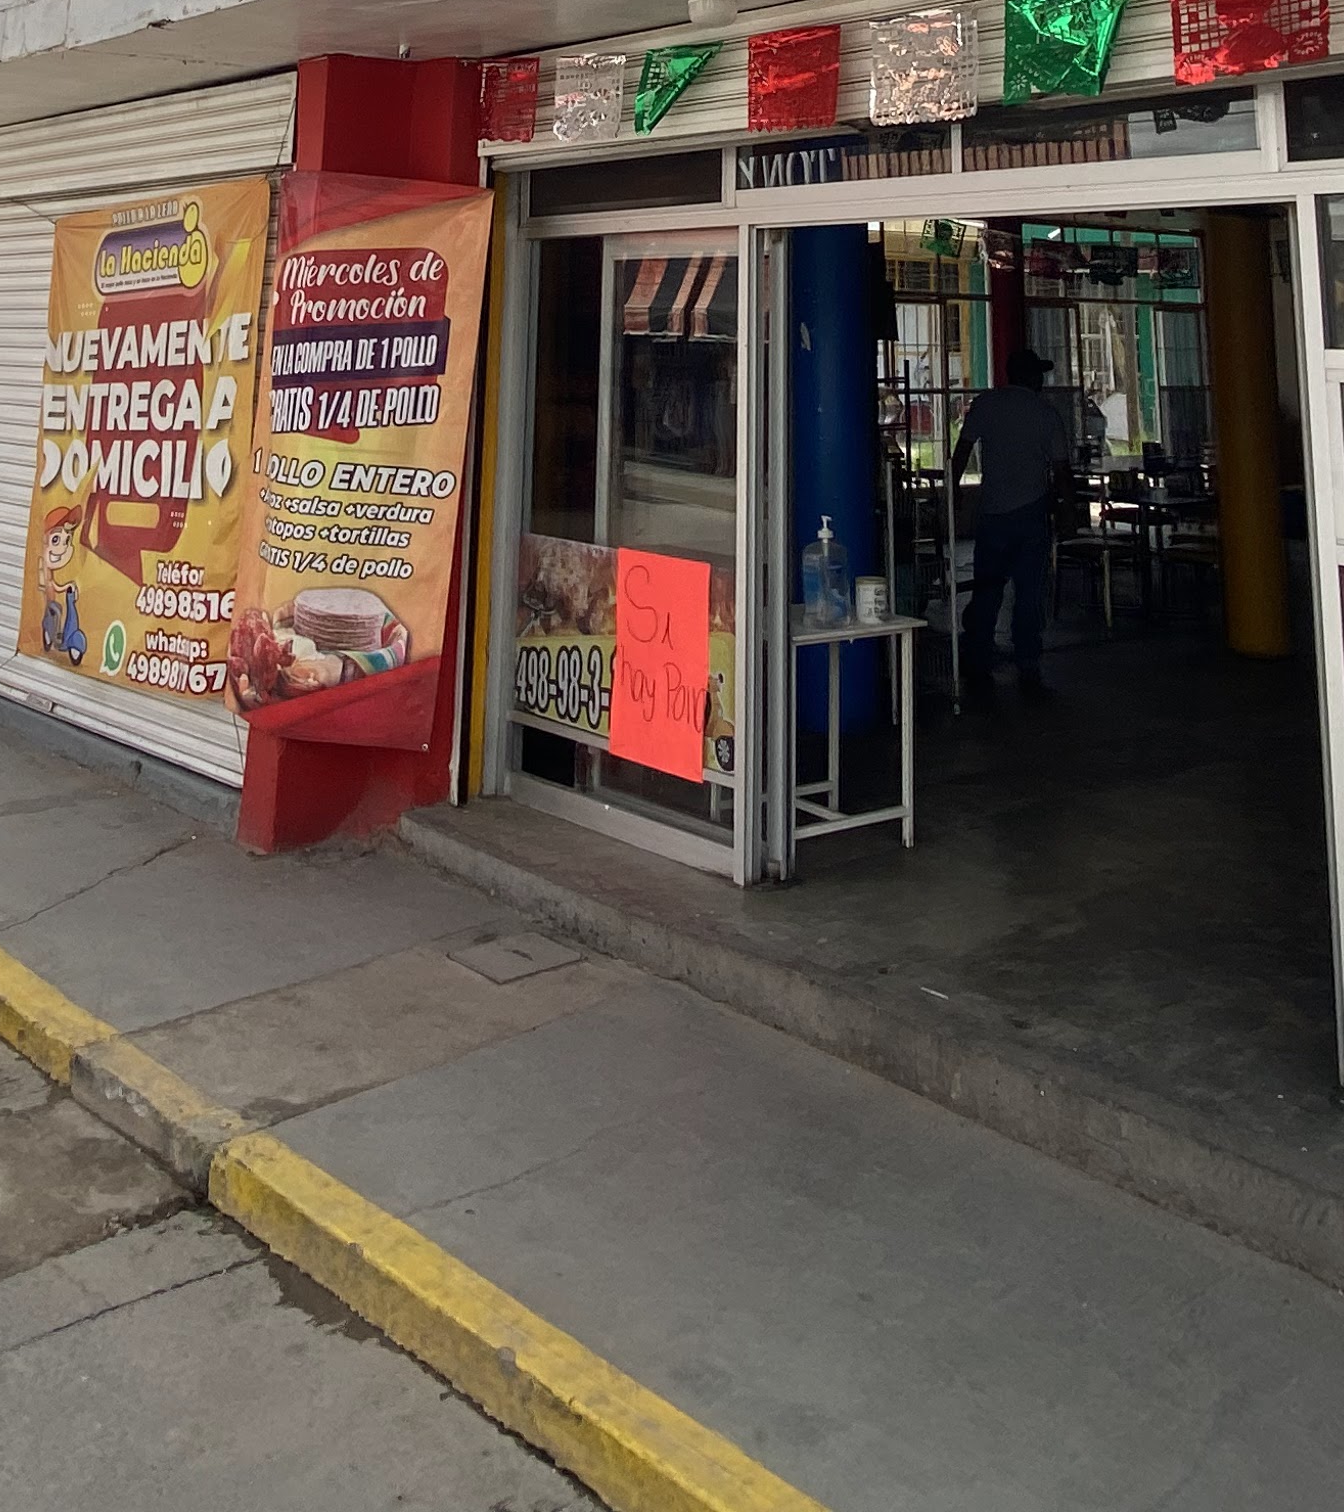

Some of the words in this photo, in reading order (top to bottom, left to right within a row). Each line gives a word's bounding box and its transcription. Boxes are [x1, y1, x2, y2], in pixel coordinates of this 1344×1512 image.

[119, 232, 204, 276] Hacienda
[409, 251, 445, 283] de
[290, 287, 428, 326] Promoción
[294, 339, 353, 375] COMPRA
[355, 337, 377, 371] DE
[380, 337, 388, 370] 1
[390, 334, 438, 369] POLLO
[42, 378, 202, 432] ENTREGA
[317, 389, 353, 431] 1/4
[354, 387, 381, 429] DE
[381, 383, 442, 426] POLLO
[266, 453, 326, 489] OLLO
[329, 461, 457, 499] ENTERO
[345, 501, 435, 525] +verdura
[319, 523, 411, 548] +tortillas
[292, 551, 327, 574] 1/4
[330, 553, 358, 575] de
[359, 558, 414, 580] pollo
[516, 645, 616, 730] 498-98-3-
[620, 642, 656, 722] hay
